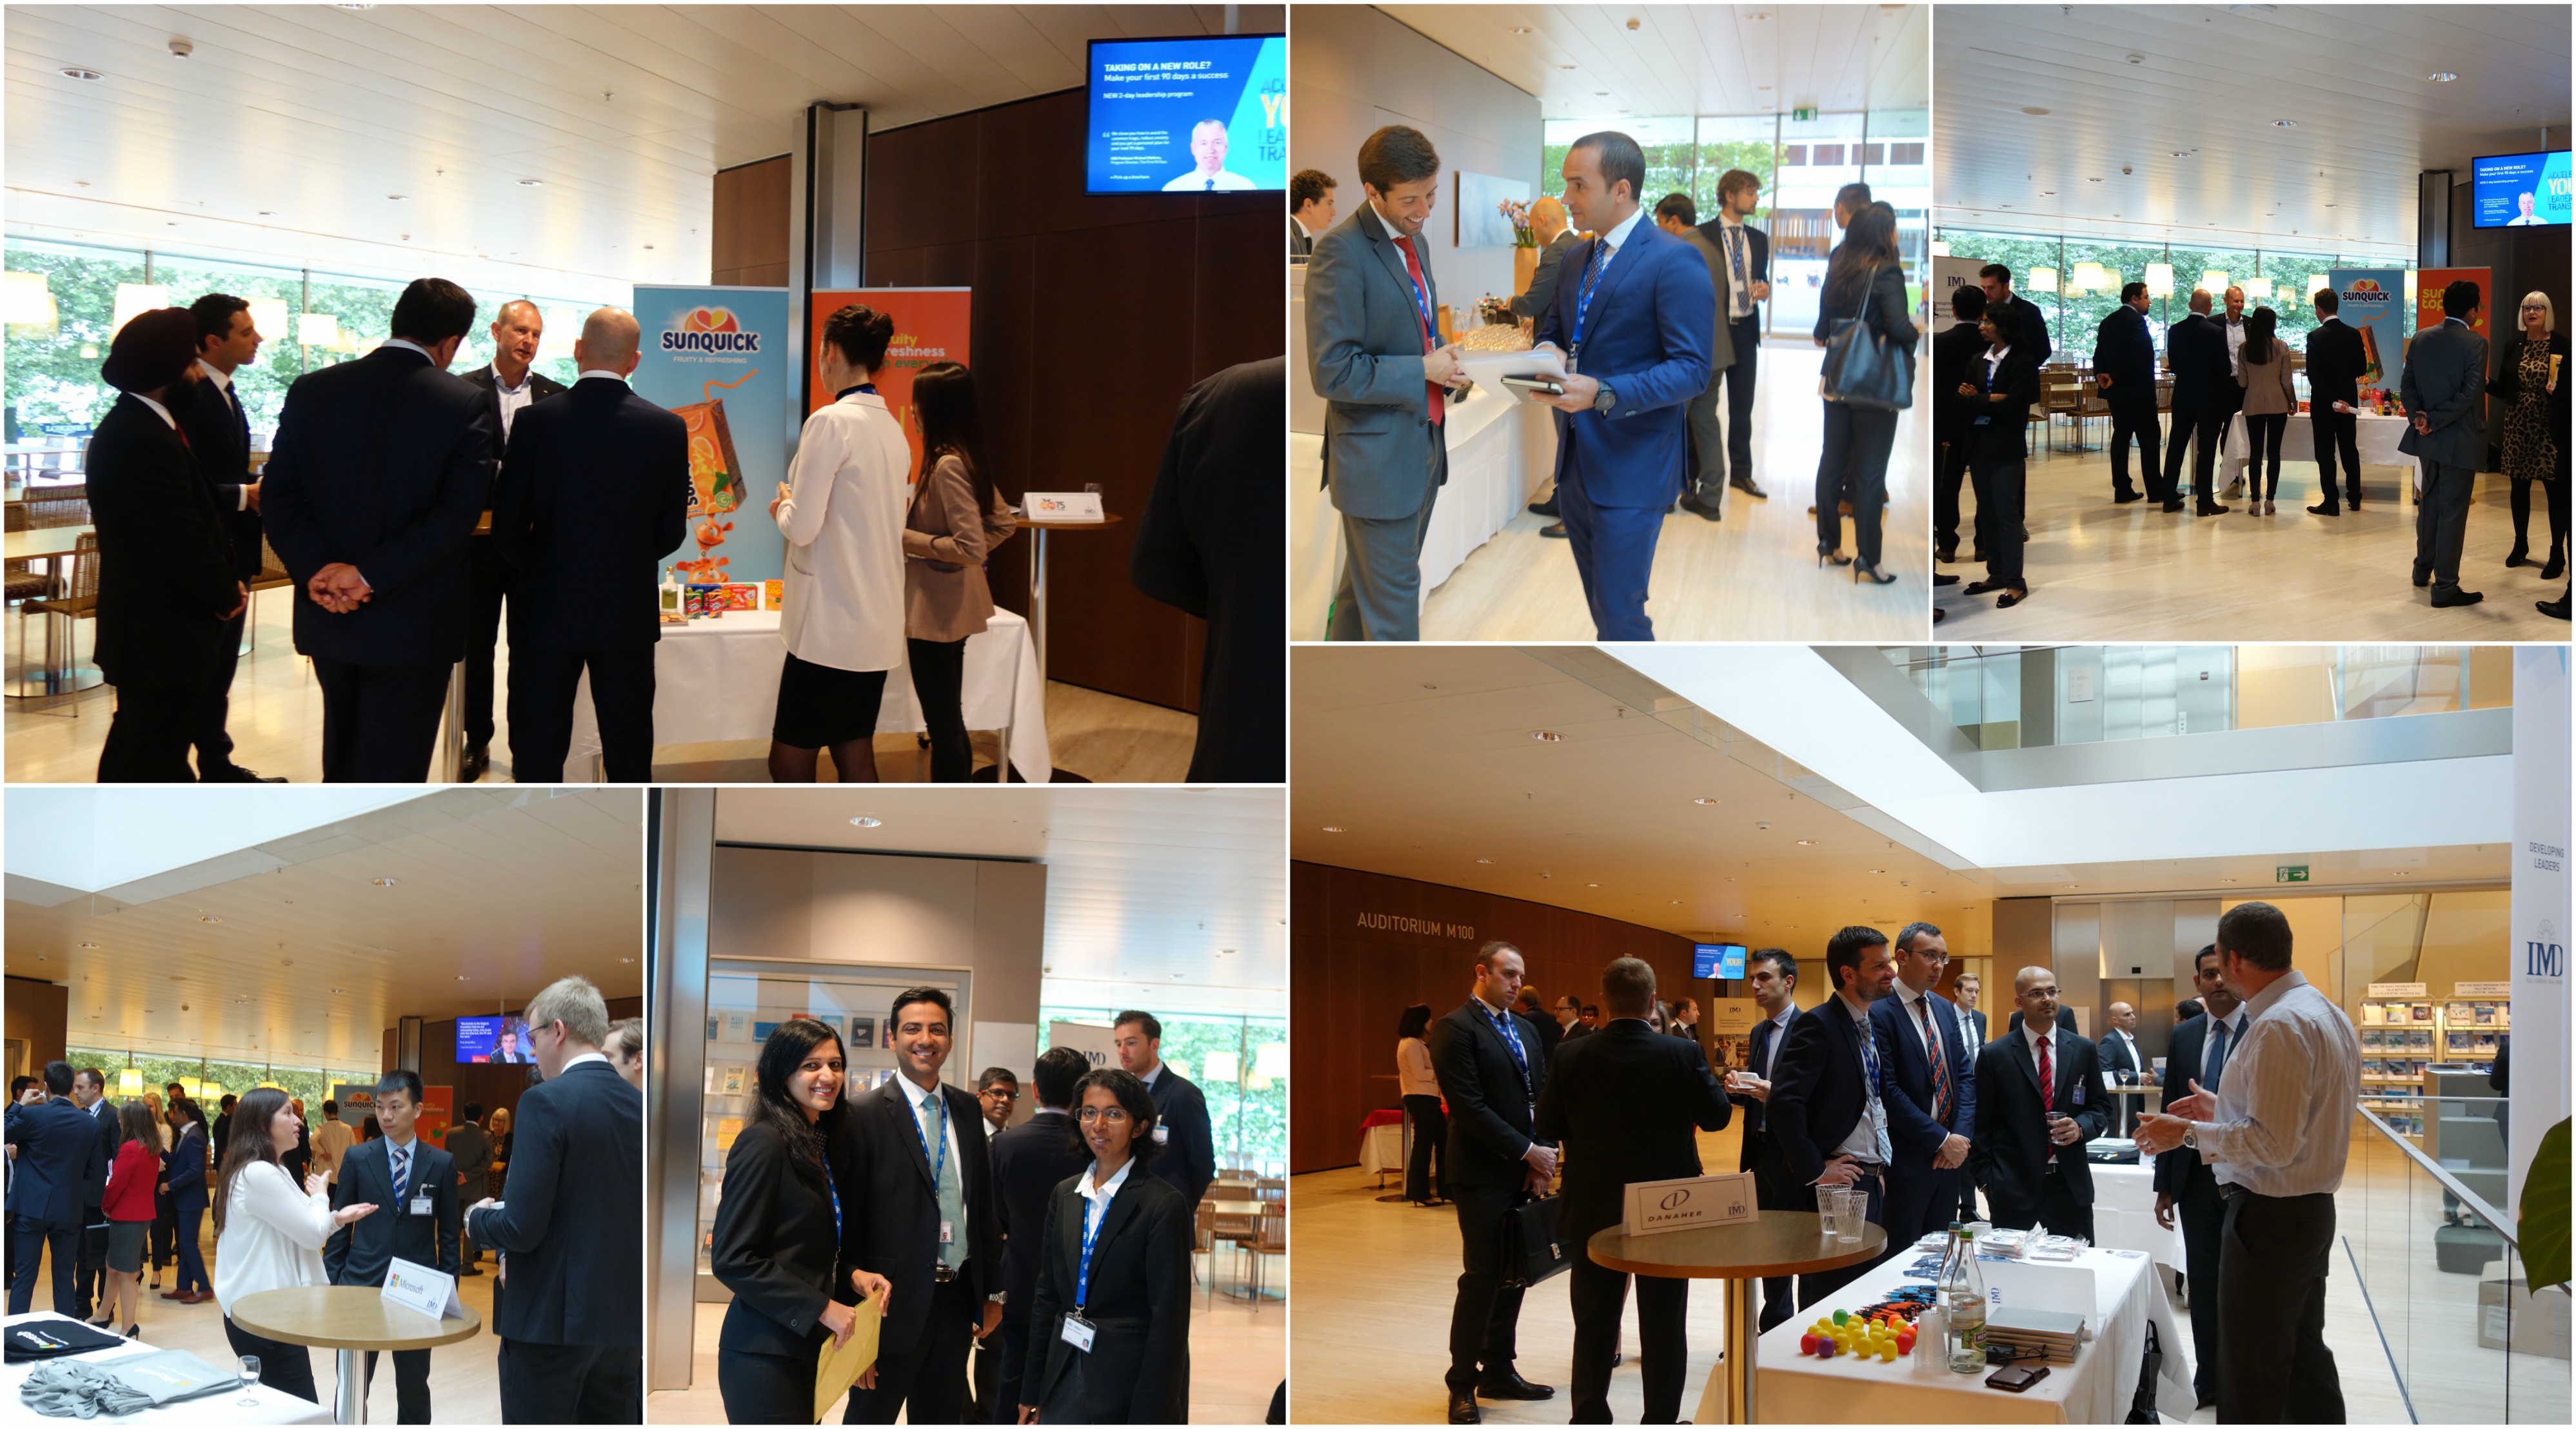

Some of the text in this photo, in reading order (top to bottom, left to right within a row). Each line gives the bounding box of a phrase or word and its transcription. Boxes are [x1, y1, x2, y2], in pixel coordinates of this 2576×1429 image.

[1104, 63, 1136, 72] TAKING
[1160, 62, 1182, 70] NEW
[1183, 61, 1211, 70] ROLE?
[1172, 72, 1189, 81] days
[2342, 291, 2390, 303] SUNQUICK
[662, 331, 759, 353] SUNQUICK
[890, 333, 918, 348] uity
[885, 346, 946, 357] reshness
[2530, 842, 2564, 858] DEVELOPING
[2534, 858, 2560, 872] LEADERS
[1357, 912, 1474, 940] AUDITORIUM M100
[1726, 958, 1743, 966] YOUR
[2526, 941, 2563, 977] IMD
[344, 1101, 376, 1109] SUNQUIC
[1648, 1210, 1703, 1222] DANAHER
[1729, 1205, 1745, 1216] IMD
[399, 1278, 424, 1295] Microsoft
[1990, 1287, 2001, 1304] IMD
